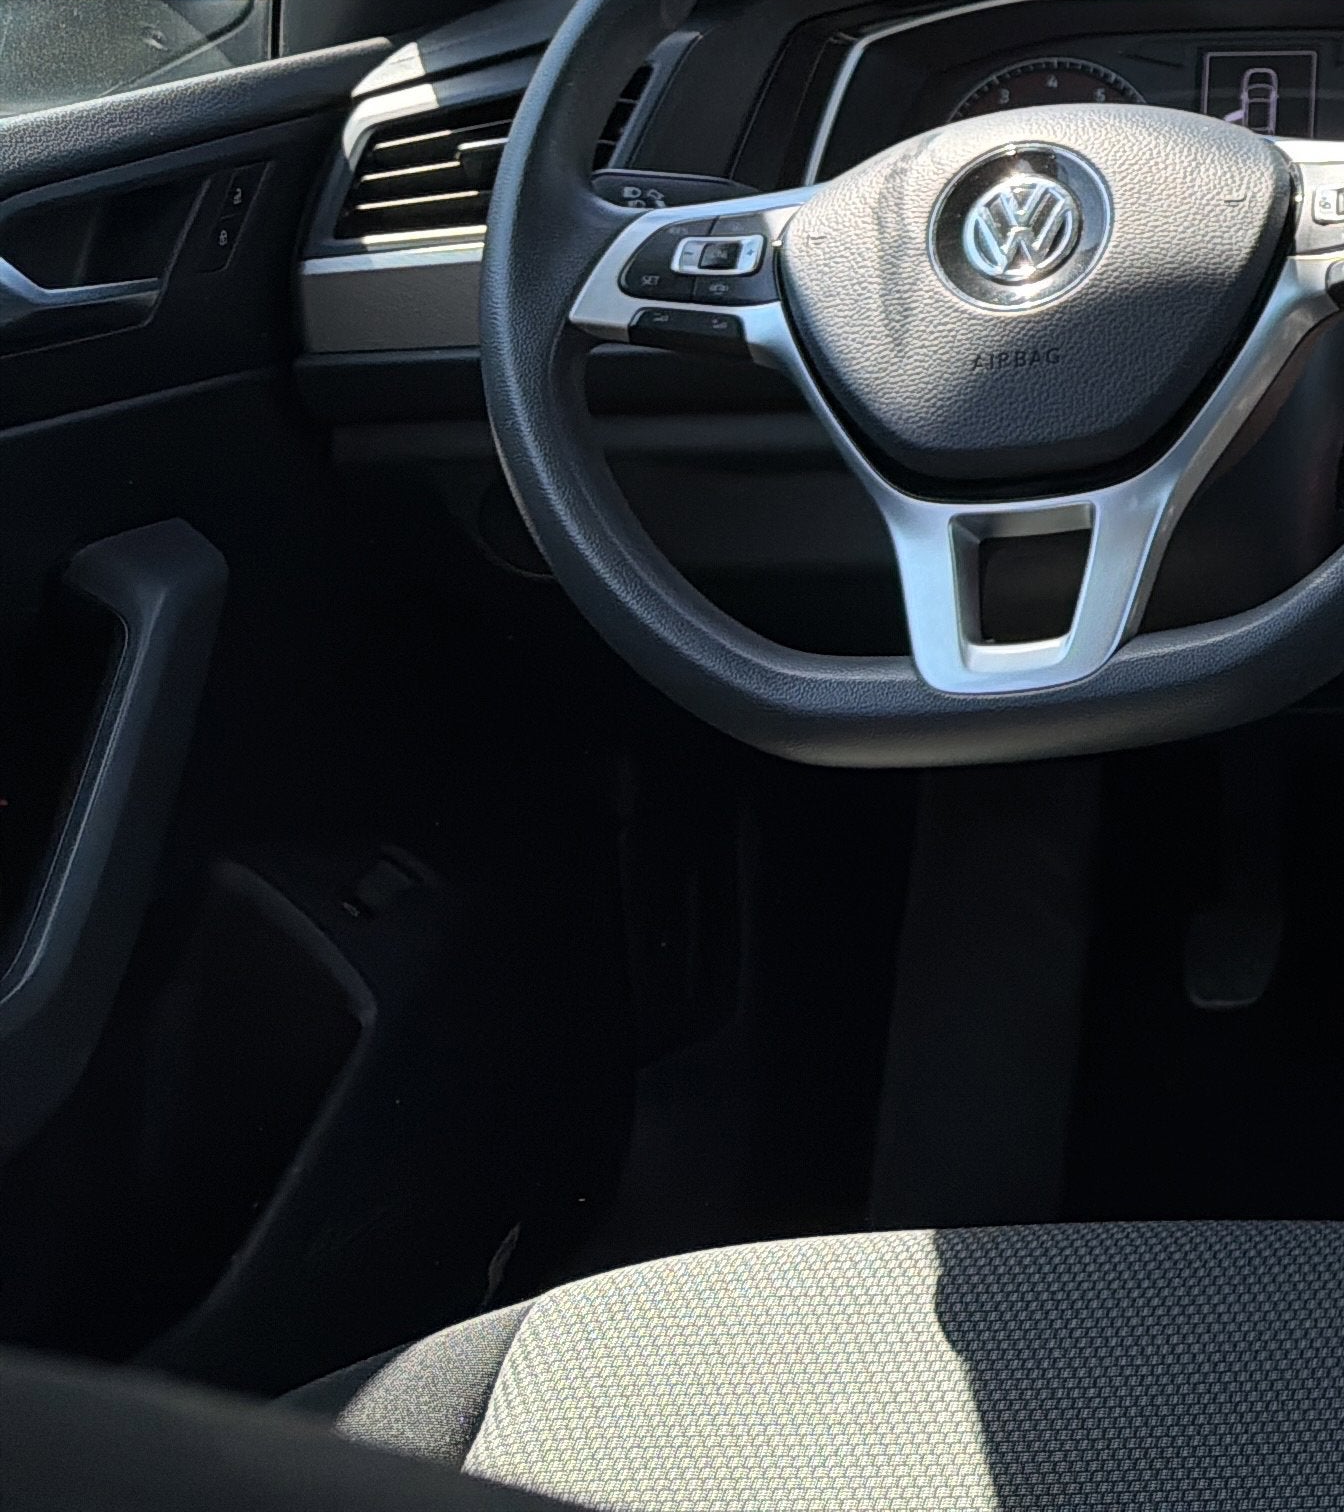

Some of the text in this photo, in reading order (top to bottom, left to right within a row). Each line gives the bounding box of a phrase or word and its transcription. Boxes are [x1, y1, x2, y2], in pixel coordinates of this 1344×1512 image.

[1048, 75, 1058, 87] 4
[641, 274, 660, 286] SET
[973, 347, 1061, 372] AIRBAG
